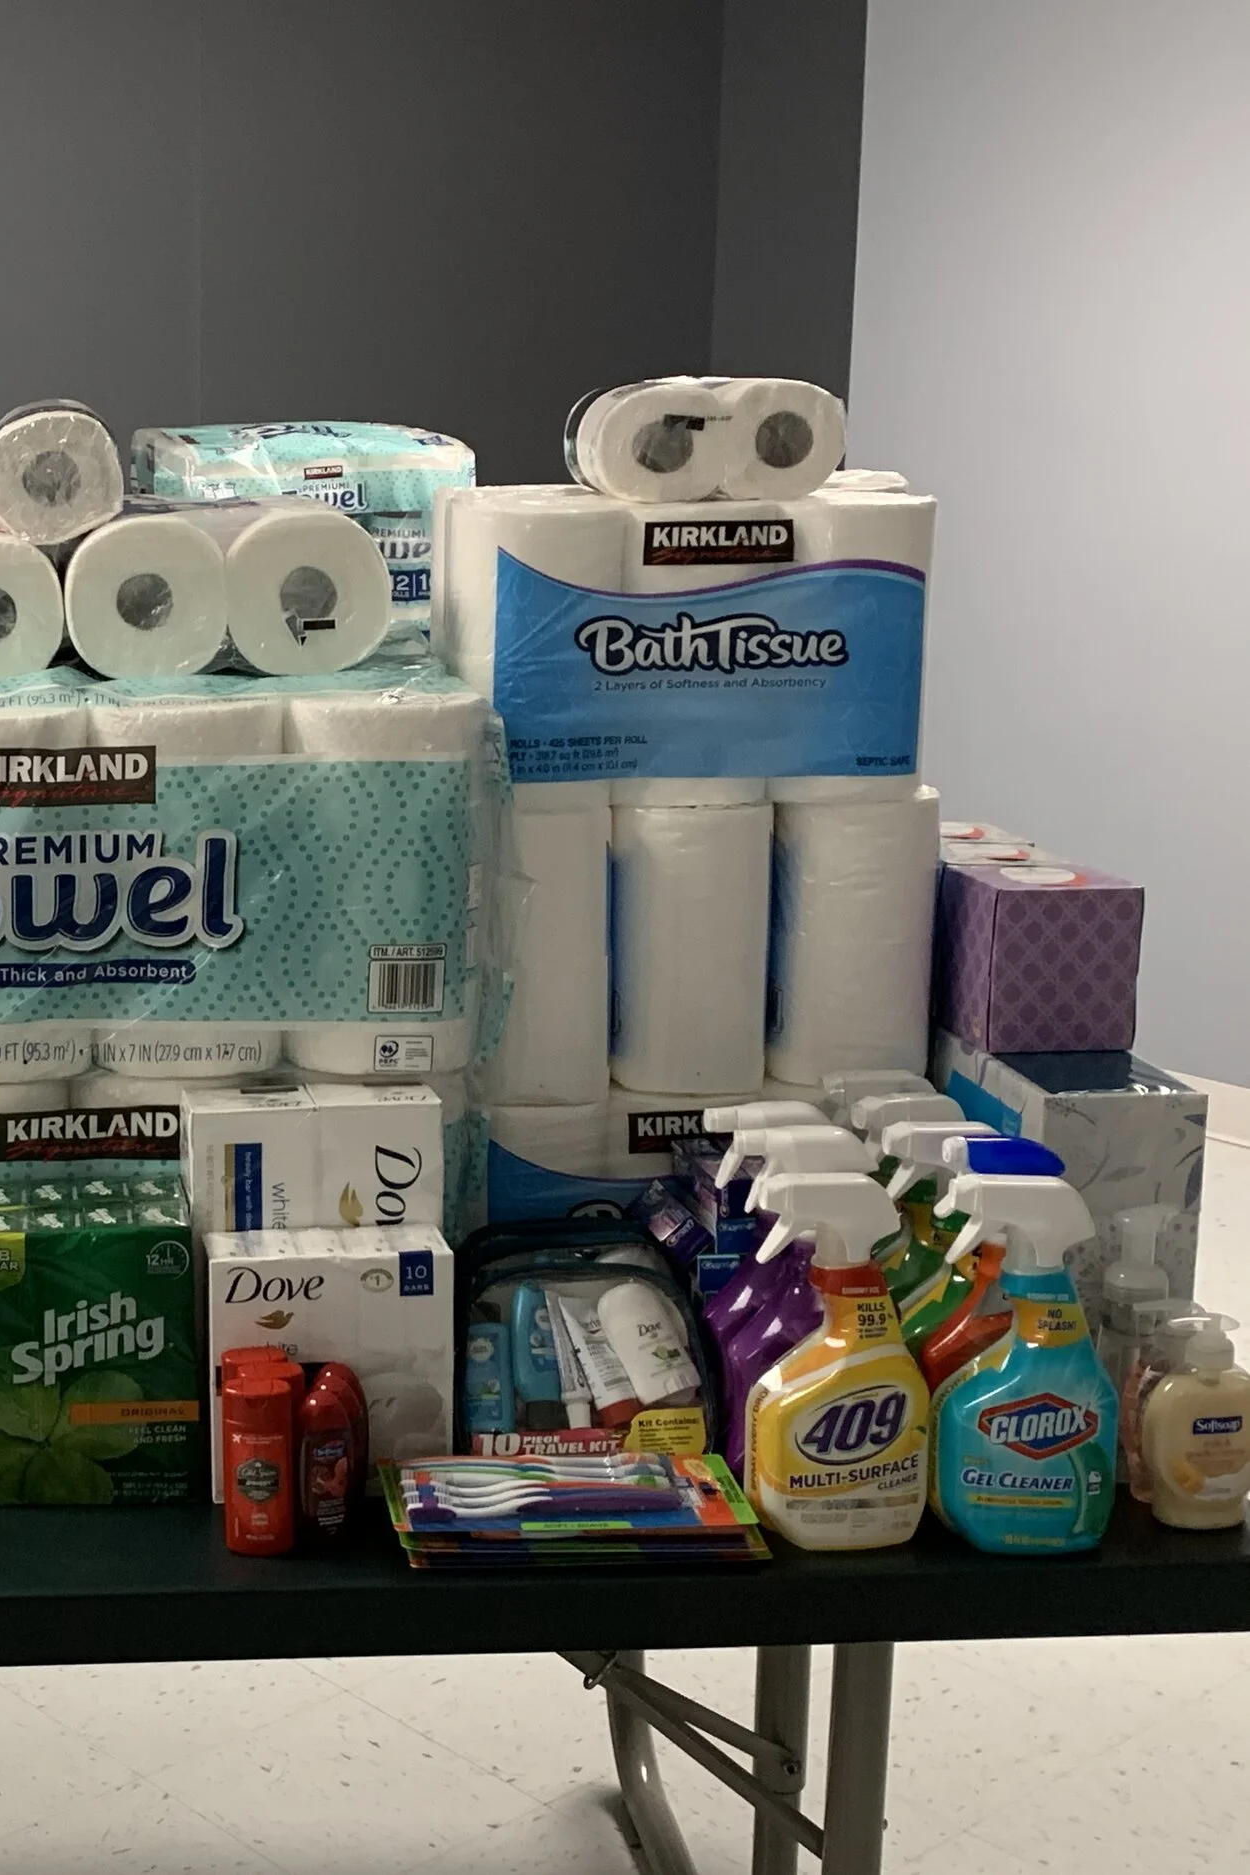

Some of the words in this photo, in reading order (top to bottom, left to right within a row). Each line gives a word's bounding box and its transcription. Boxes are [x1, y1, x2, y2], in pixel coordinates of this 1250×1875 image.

[306, 466, 343, 475] KIRKLAND
[282, 483, 366, 508] wel
[302, 482, 348, 492] PREMIUM
[652, 523, 789, 548] KIRKLAND
[595, 681, 602, 691] 2
[606, 680, 647, 693] Layers
[650, 678, 663, 690] of
[666, 677, 720, 690] Softness
[723, 677, 748, 689] and
[751, 676, 827, 691] Absorbency
[567, 737, 602, 748] SHEETS
[603, 736, 622, 746] PER
[624, 734, 648, 744] ROLL
[855, 755, 888, 767] SEPTIC
[889, 754, 911, 766] SAFE
[0, 967, 48, 983] Thick
[53, 967, 88, 982] and
[93, 962, 189, 980] Absorbent
[3, 1043, 20, 1062] FT
[102, 1042, 117, 1063] IN
[128, 1042, 136, 1062] 7
[138, 1042, 152, 1063] IN
[183, 1047, 202, 1062] cm
[237, 1039, 263, 1064] cm)
[6, 1111, 179, 1143] KIRKLAND
[637, 1115, 703, 1138] KIRK
[374, 1144, 423, 1227] Do
[271, 1181, 291, 1230] white
[145, 1253, 160, 1266] 12
[405, 1265, 428, 1281] 10
[224, 1266, 326, 1304] Dove
[403, 1283, 430, 1292] BARS
[857, 1302, 887, 1312] KILLS
[1047, 1308, 1063, 1319] NO
[42, 1290, 138, 1345] Irish
[10, 1315, 167, 1387] Spring
[752, 1388, 770, 1413] DRO
[154, 1424, 187, 1434] CLEAN
[637, 1418, 655, 1429] Kit
[655, 1417, 700, 1427] Contains:
[800, 1391, 907, 1456] 409
[988, 1402, 1091, 1444] CLOROX
[1196, 1419, 1241, 1433] Softsoap
[133, 1436, 154, 1444] AND
[156, 1435, 187, 1444] FRESH
[478, 1432, 521, 1457] 10
[522, 1434, 561, 1445] PIECE
[522, 1441, 586, 1456] TRAVEL
[588, 1439, 621, 1453] KIT
[789, 1454, 919, 1489] MULTI-SURFACE
[962, 1469, 994, 1487] GEL
[998, 1472, 1074, 1491] CLEANER
[877, 1473, 919, 1491] CLEANER
